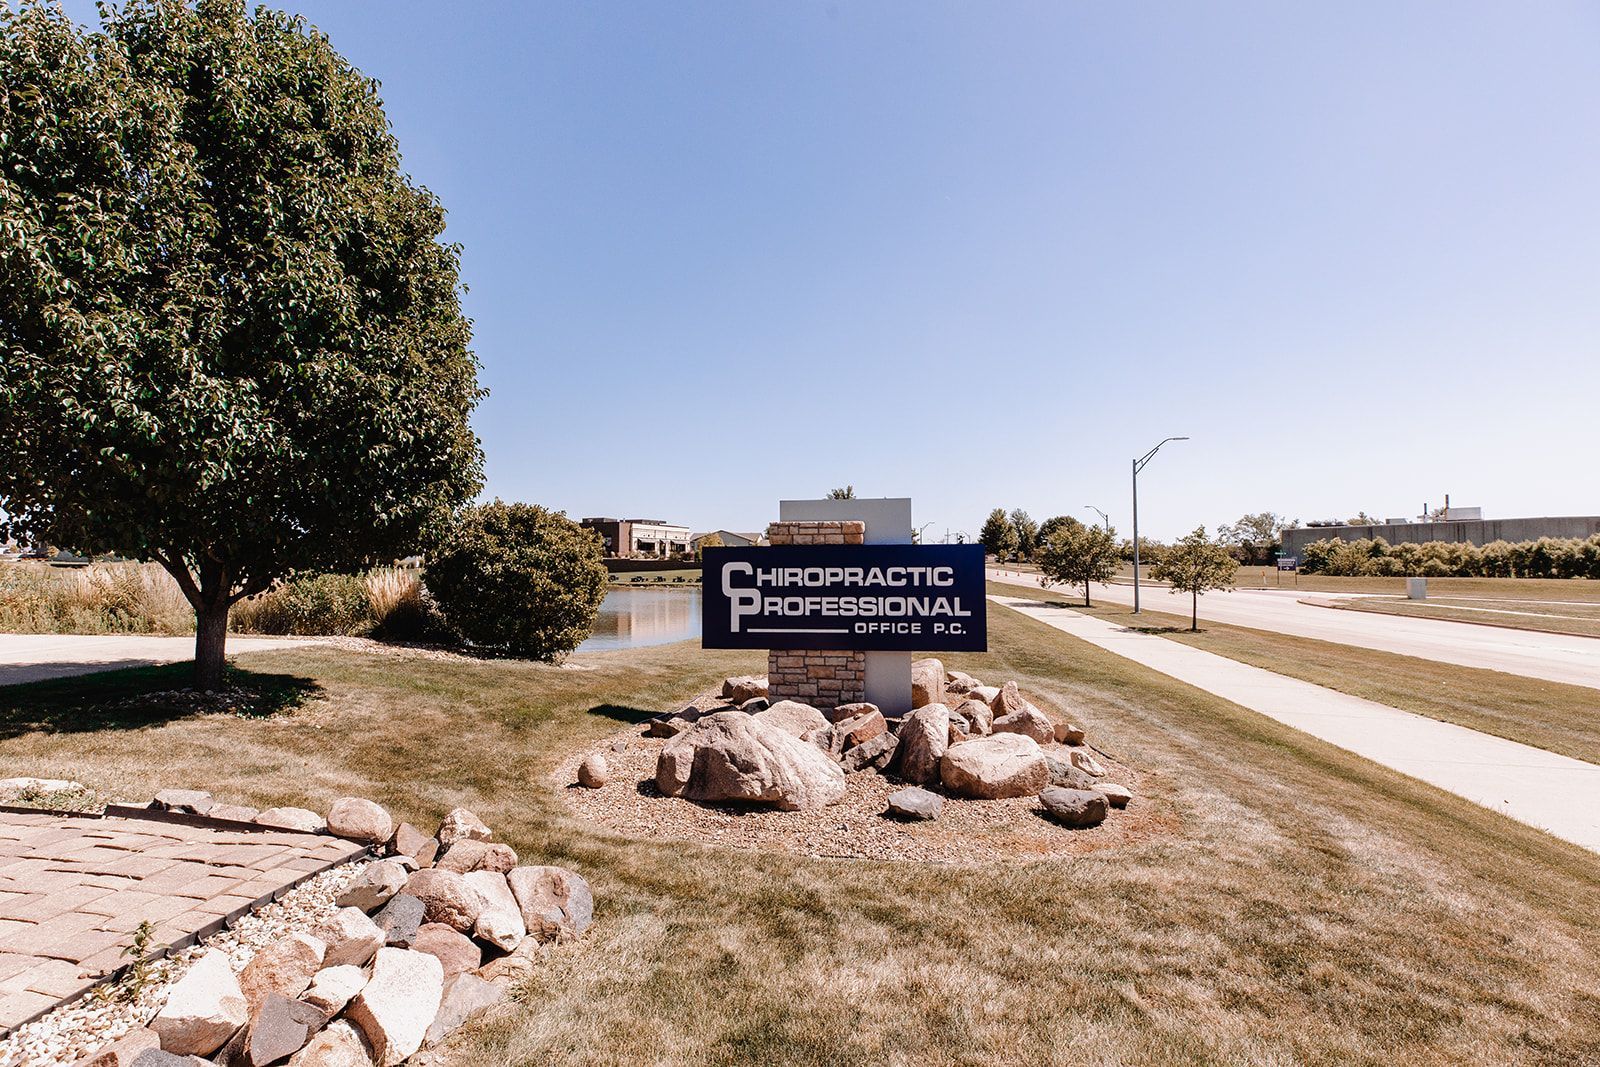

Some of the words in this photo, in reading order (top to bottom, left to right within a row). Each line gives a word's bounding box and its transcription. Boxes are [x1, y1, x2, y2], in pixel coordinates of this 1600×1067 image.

[721, 561, 954, 598] CHIROPRACTIC
[730, 588, 972, 633] PROFESSIONAL
[854, 622, 922, 634] OFFICE
[933, 622, 967, 635] P.C.
